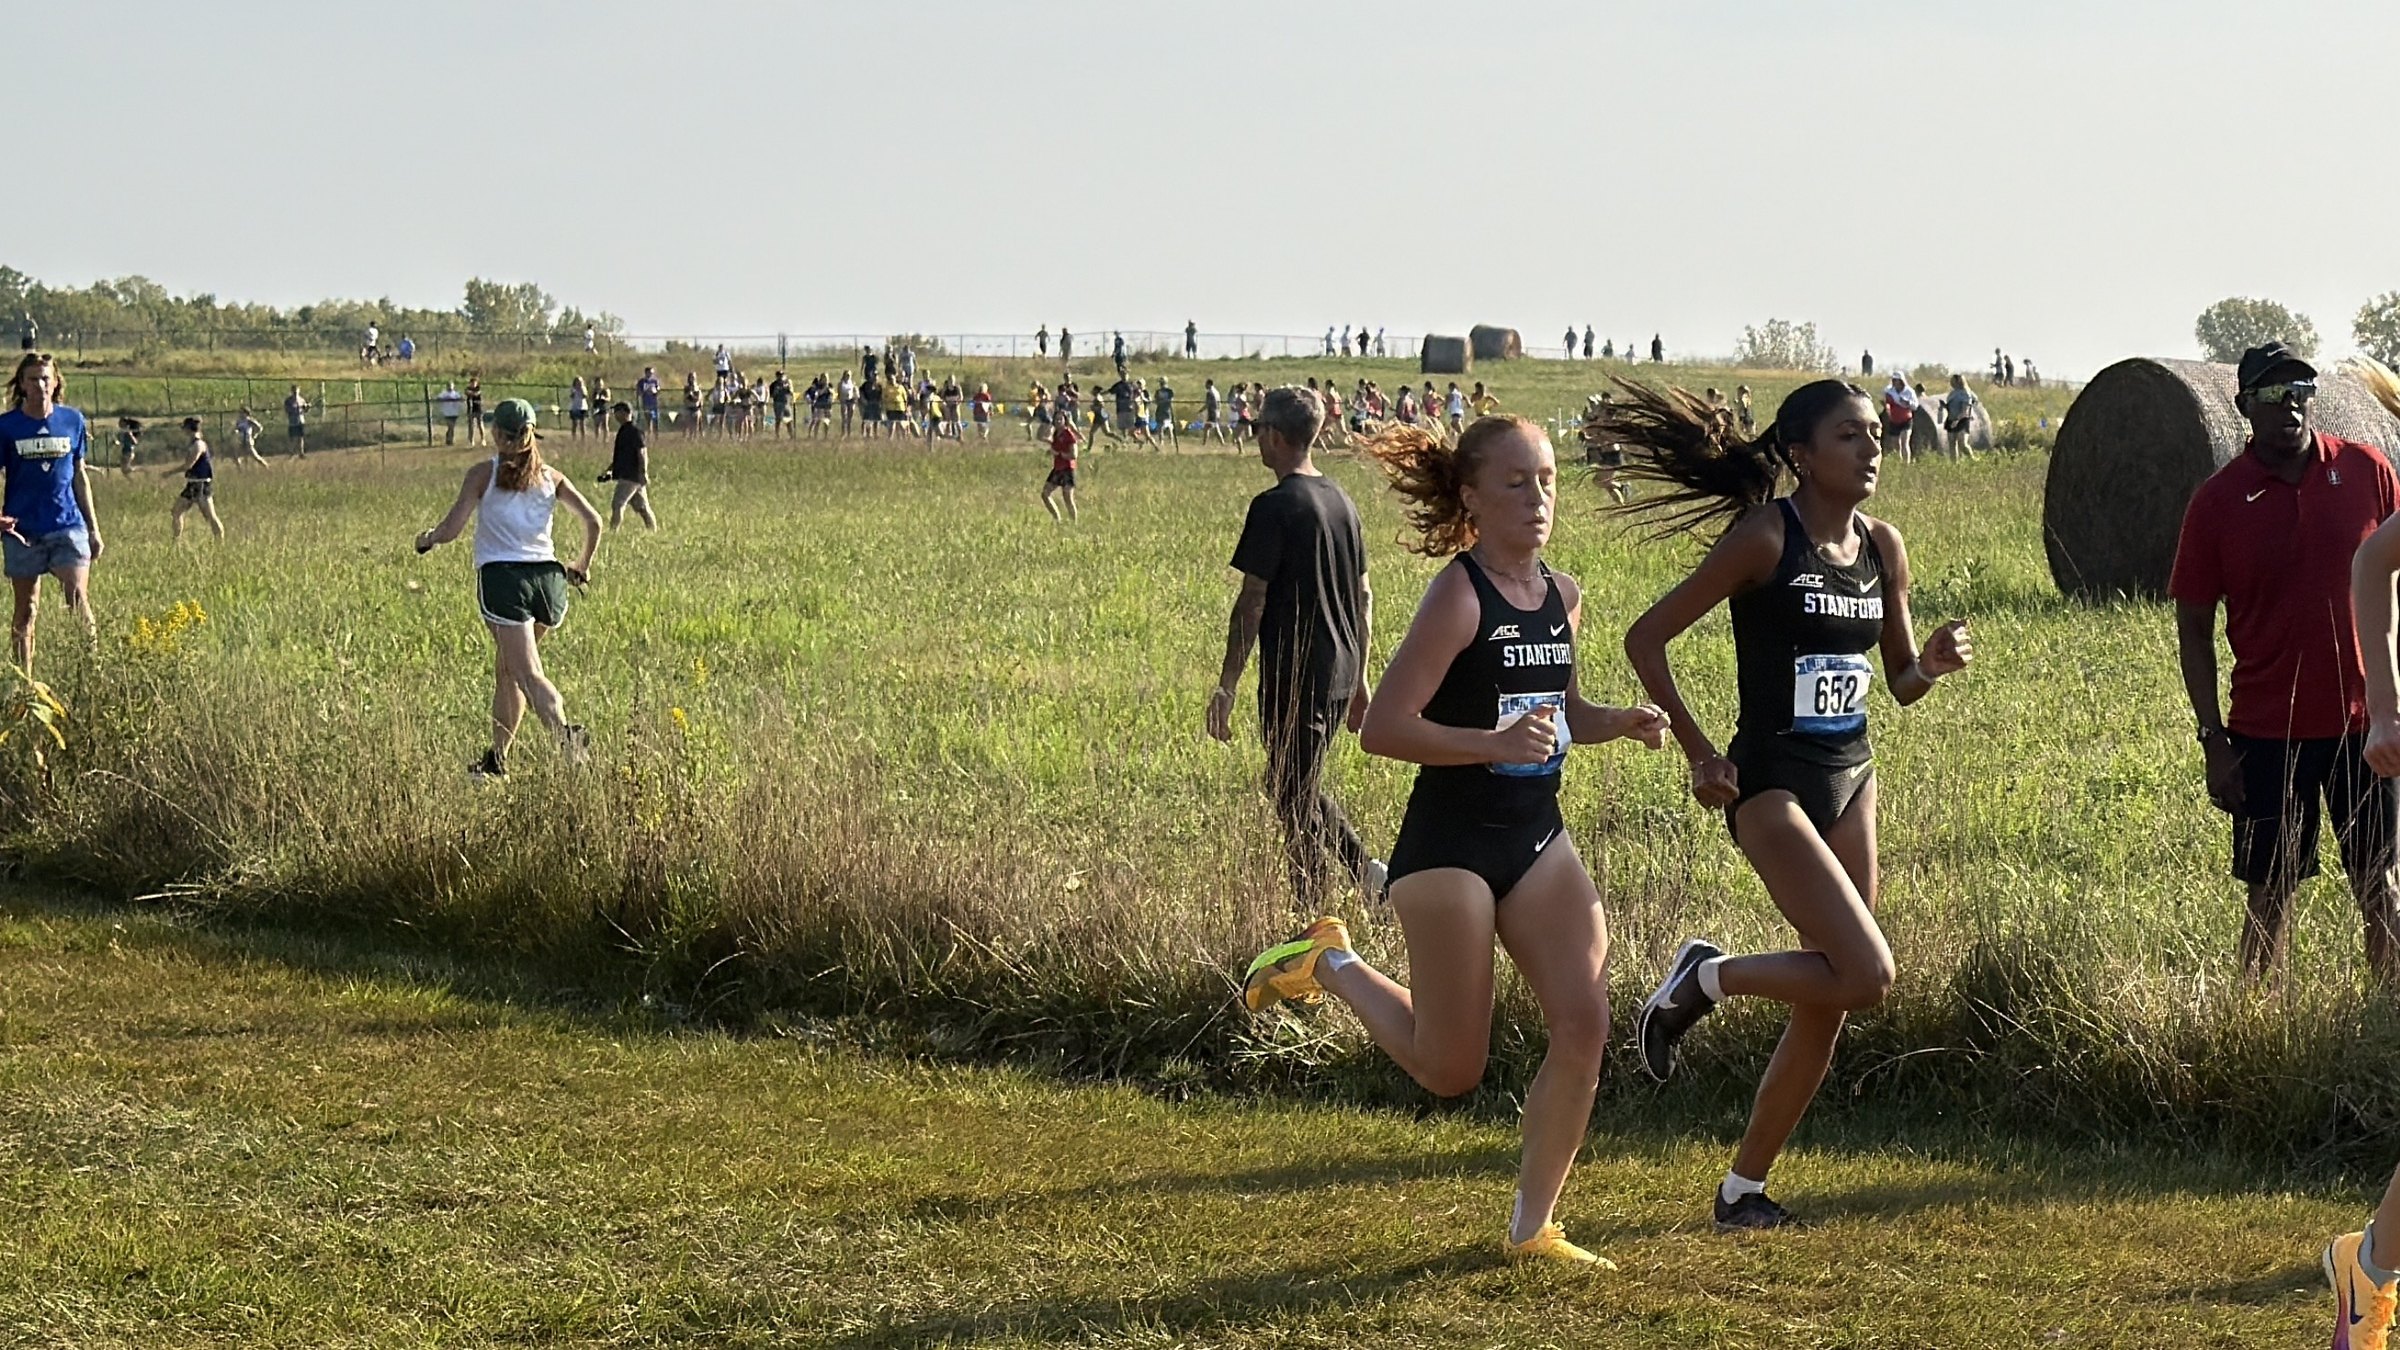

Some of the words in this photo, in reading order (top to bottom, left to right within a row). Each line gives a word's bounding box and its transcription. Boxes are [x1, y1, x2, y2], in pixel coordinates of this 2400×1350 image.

[1789, 573, 1824, 588] ACC
[1489, 624, 1521, 640] ACC
[1814, 675, 1858, 715] 652
